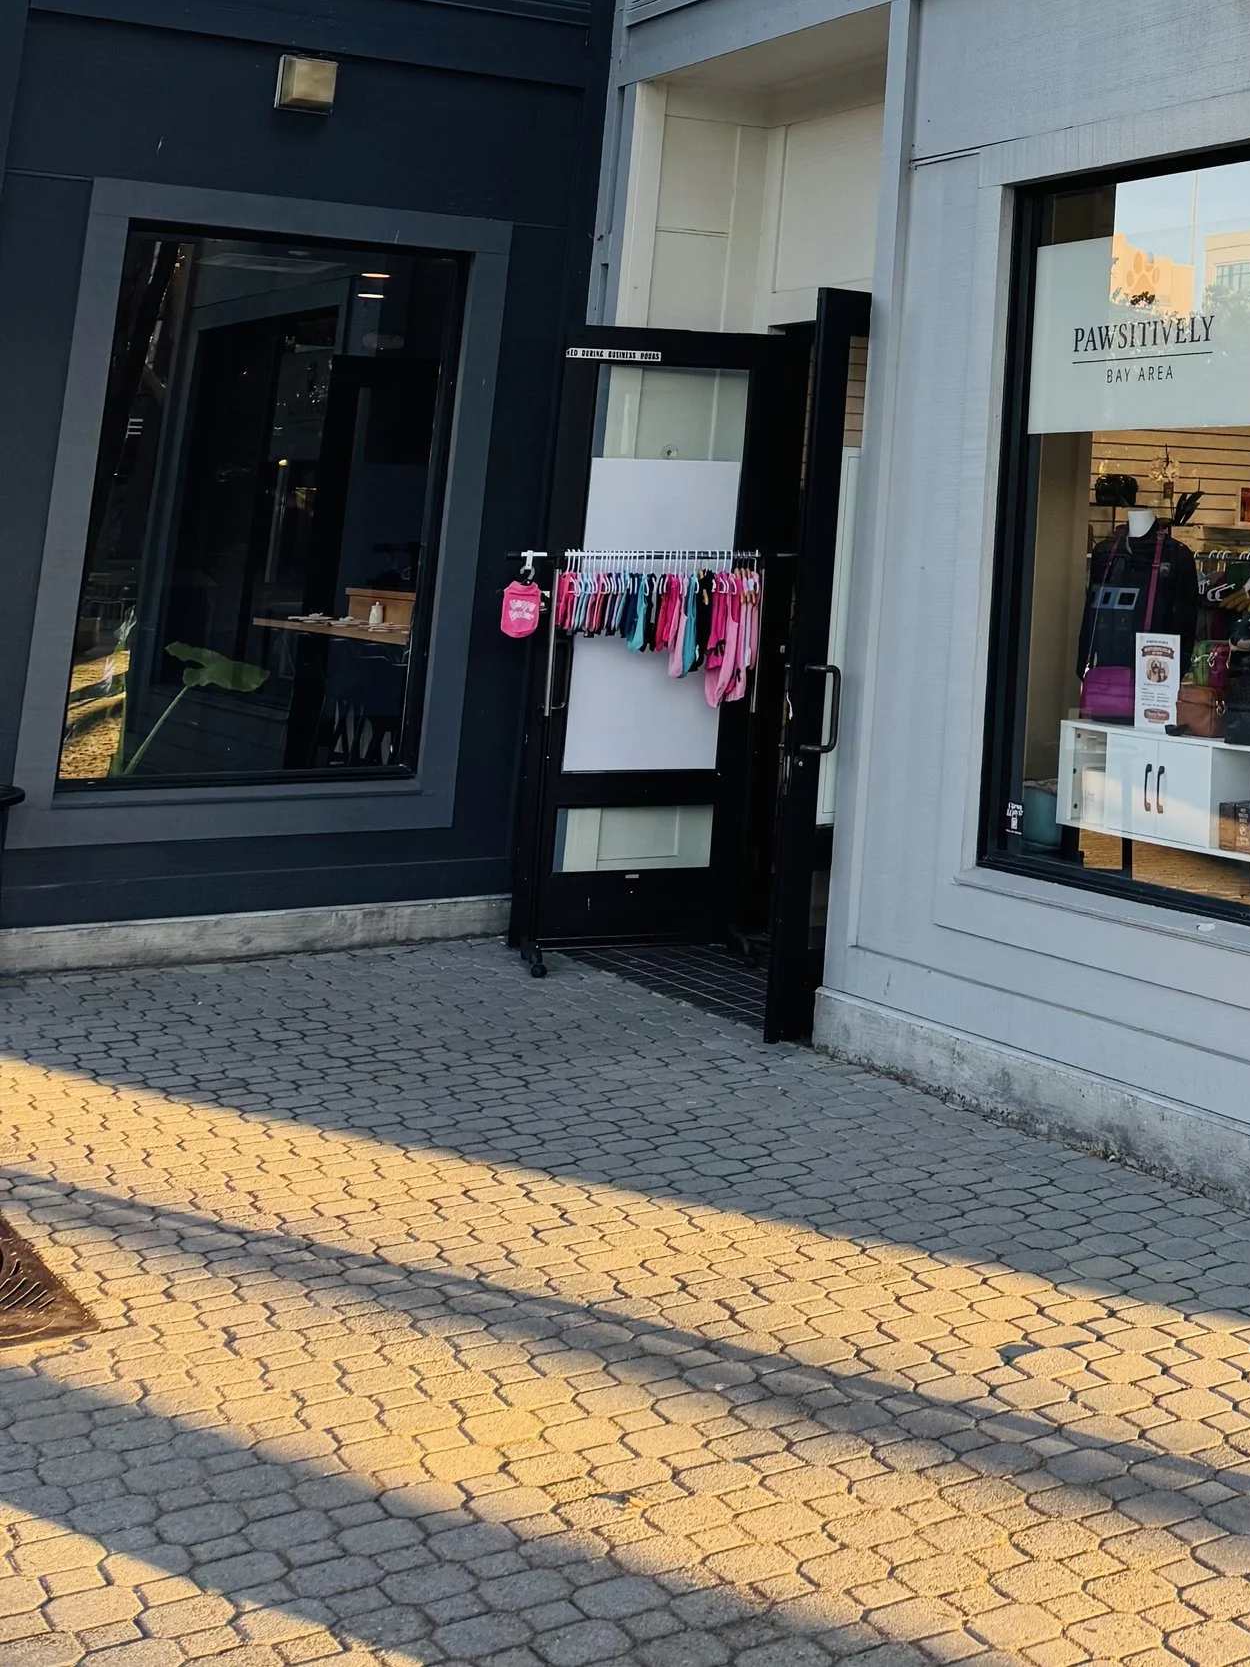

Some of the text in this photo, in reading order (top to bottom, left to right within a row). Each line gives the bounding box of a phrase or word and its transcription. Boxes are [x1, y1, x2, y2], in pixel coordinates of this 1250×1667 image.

[1073, 315, 1215, 352] PAWSITIVELY
[608, 351, 636, 359] BUSINESS
[1106, 365, 1174, 383] BAY AREA
